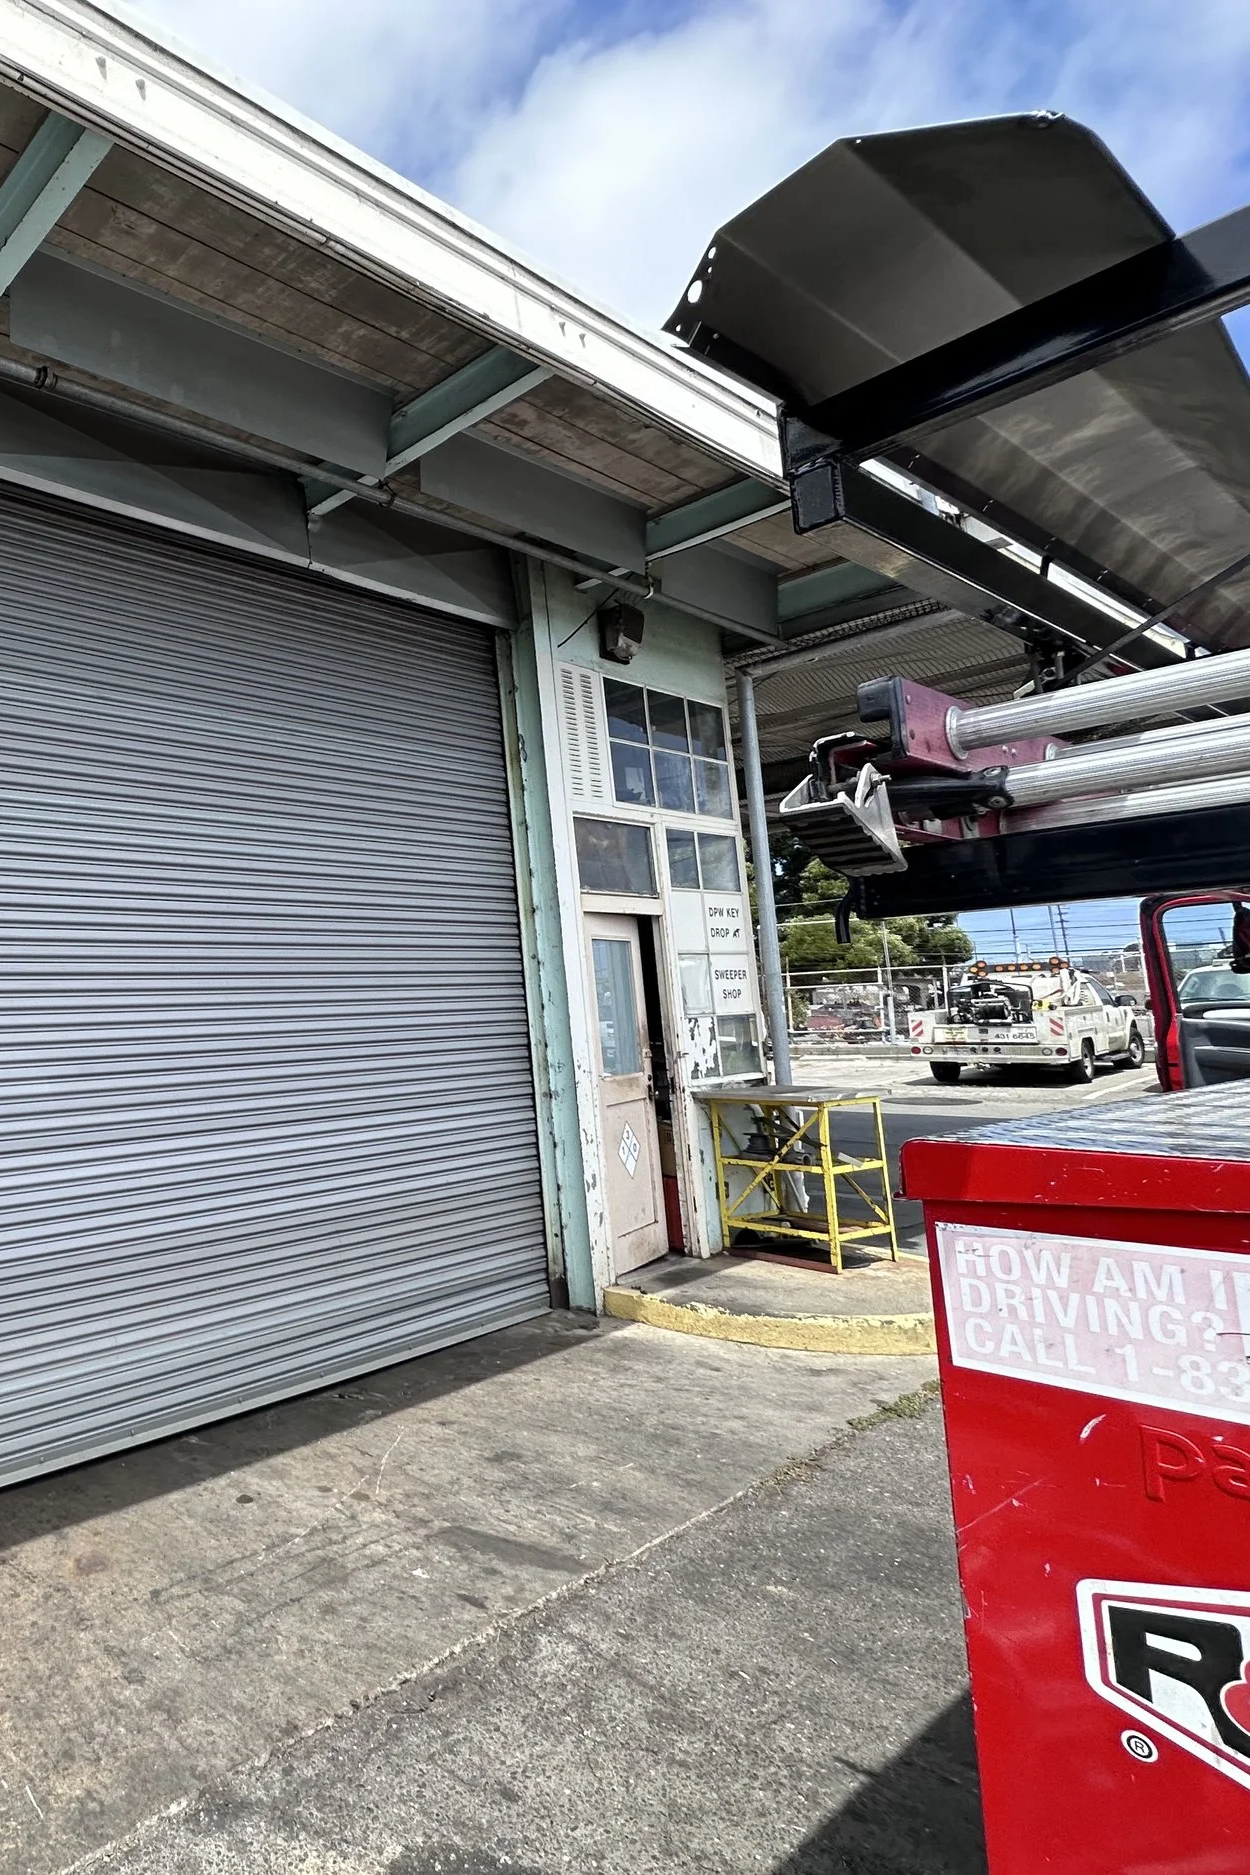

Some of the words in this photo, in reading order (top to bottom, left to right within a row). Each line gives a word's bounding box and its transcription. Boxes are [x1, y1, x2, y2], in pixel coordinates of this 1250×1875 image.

[708, 906, 724, 917] DPW
[726, 907, 740, 918] KEY
[710, 927, 730, 938] DROP
[714, 969, 747, 980] SWEEPER
[722, 988, 742, 999] SHOP
[955, 1239, 1073, 1288] HOW
[1092, 1256, 1187, 1305] AM
[1209, 1269, 1229, 1310] I
[958, 1276, 1225, 1353] DRIVING?
[964, 1317, 1097, 1374] CALL
